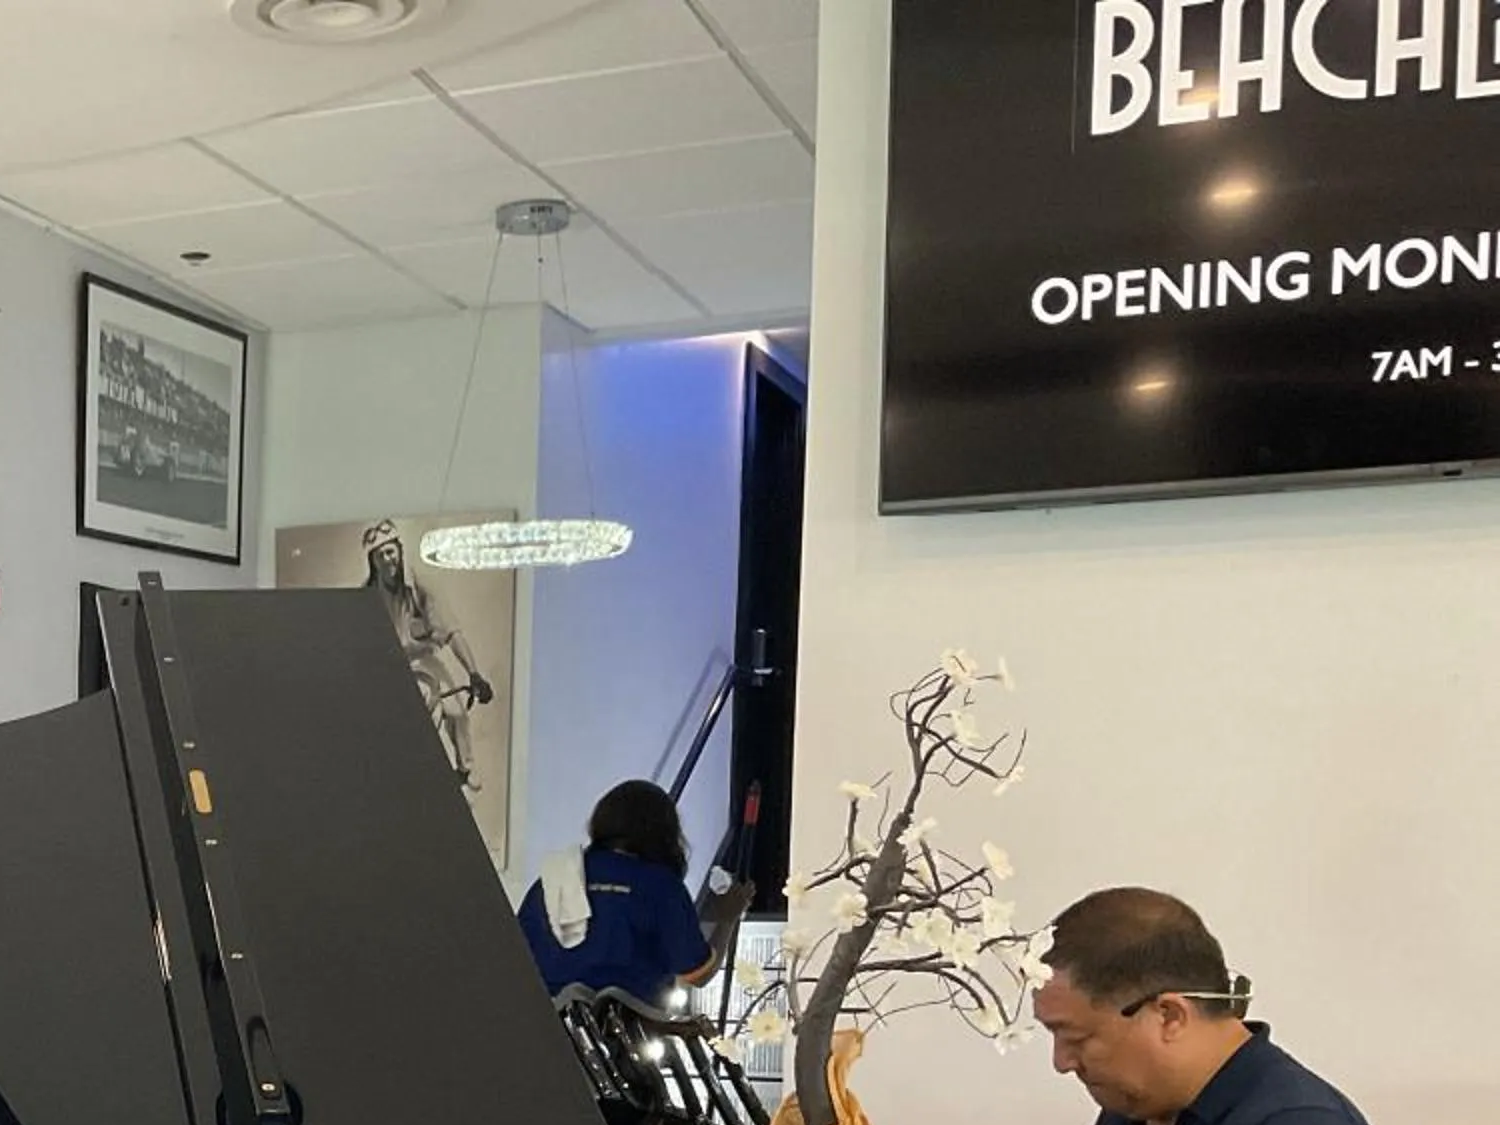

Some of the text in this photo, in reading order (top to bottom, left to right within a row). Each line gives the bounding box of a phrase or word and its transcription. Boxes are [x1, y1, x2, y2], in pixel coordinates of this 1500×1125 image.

[1031, 230, 1500, 325] OPENING MON
[1371, 345, 1453, 383] 7AM
